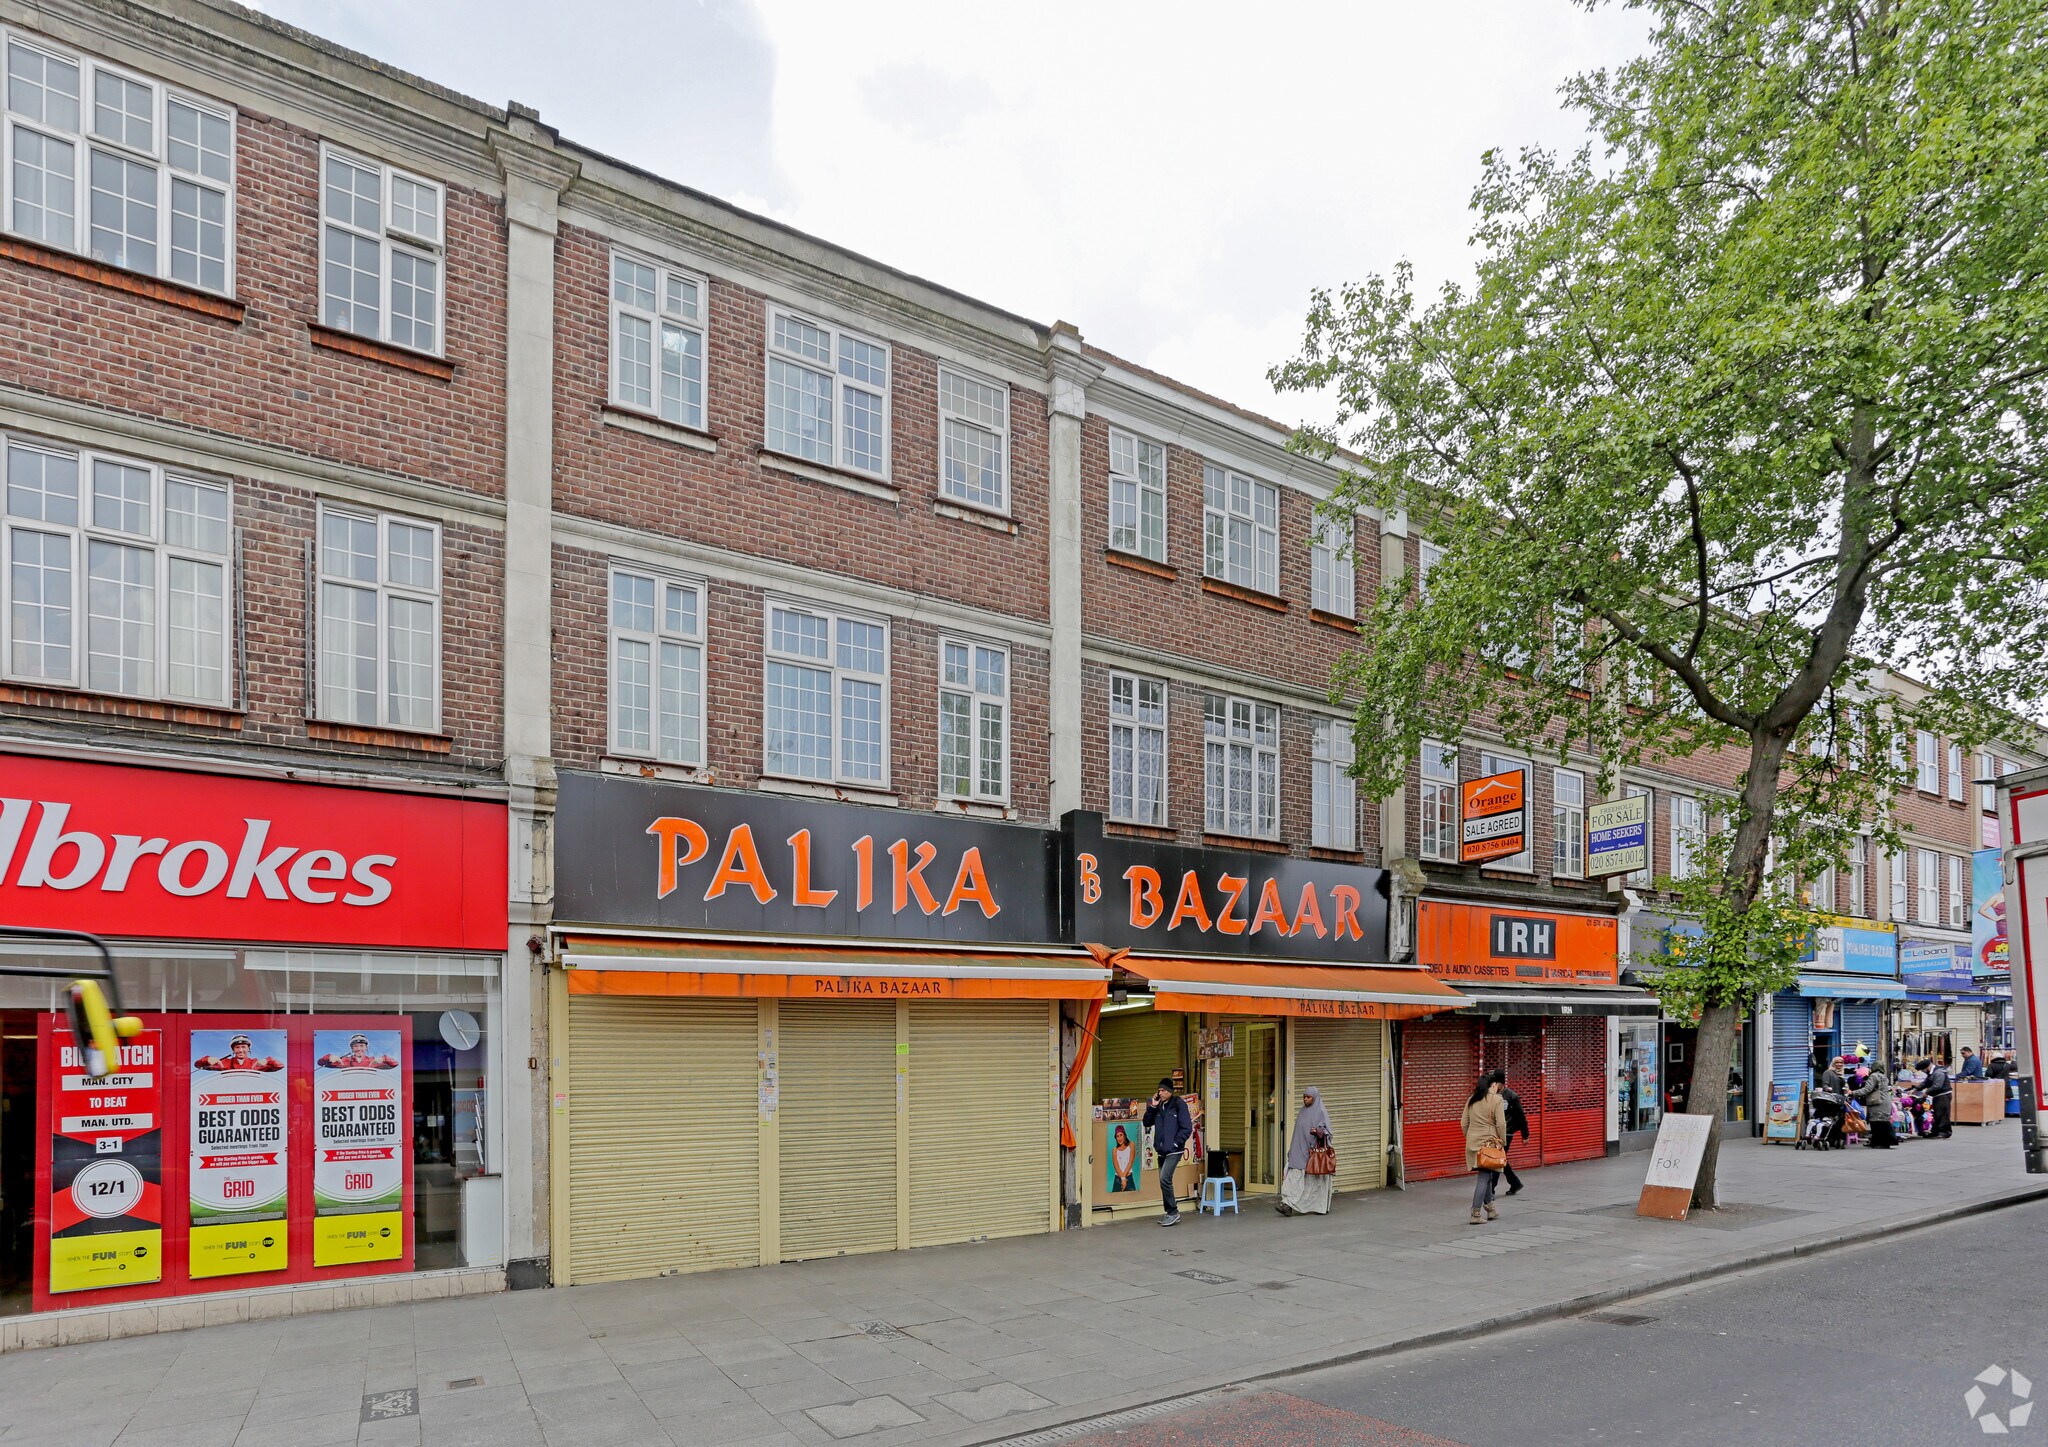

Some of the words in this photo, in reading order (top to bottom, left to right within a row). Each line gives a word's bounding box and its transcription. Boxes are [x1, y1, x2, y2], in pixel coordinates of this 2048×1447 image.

[1469, 792, 1517, 809] Orange
[1468, 804, 1503, 815] Properties
[1600, 803, 1634, 814] FREEHOLD
[1592, 813, 1613, 828] FOR
[1616, 807, 1642, 824] SALE
[1465, 823, 1486, 837] SALE
[1487, 816, 1520, 832] AGREED
[1591, 830, 1612, 843] HOME
[1612, 825, 1642, 840] SEEKERS
[1466, 845, 1480, 853] 020
[1481, 841, 1500, 851] 8756
[1501, 838, 1519, 848] 0404
[1591, 856, 1604, 870] 020
[1605, 852, 1623, 867] 8574
[1625, 848, 1644, 864] 0012
[645, 817, 1001, 919] PALIKA
[1122, 865, 1364, 942] BAZAAR
[1497, 920, 1550, 954] IRH
[1846, 942, 1871, 955] PUNJABI
[1871, 945, 1894, 958] BAZAAR
[1912, 947, 1948, 957] Lebara
[1445, 964, 1451, 973] &
[1452, 964, 1472, 975] AUDIO
[1474, 965, 1510, 976] CASSETTES
[815, 979, 874, 994] PALIKA
[880, 981, 942, 994] BAZAAR
[1300, 1002, 1335, 1014] PALIKA
[1338, 1004, 1375, 1016] BAZAAR
[1561, 1006, 1573, 1014] IRH
[114, 1045, 154, 1066] ATCH
[82, 1078, 109, 1086] MAN.
[112, 1076, 134, 1085] CITY
[89, 1097, 102, 1108] TO
[104, 1096, 128, 1108] BEAT
[198, 1110, 236, 1128] BEST
[240, 1108, 280, 1126] ODDS
[322, 1106, 355, 1123] BEST
[359, 1104, 395, 1121] ODDS
[81, 1119, 109, 1128] MAN.
[112, 1117, 134, 1127] UTD.
[322, 1121, 395, 1139] GUARANTEED
[1664, 1118, 1704, 1132] SPECIAL
[198, 1126, 280, 1144] GUARANTEED
[99, 1140, 118, 1150] 3-1
[1656, 1158, 1680, 1169] FOR
[89, 1180, 125, 1196] 12/1
[223, 1179, 255, 1198] GRID
[345, 1173, 373, 1190] GRID
[346, 1231, 367, 1239] FUN
[225, 1241, 247, 1250] FUN
[92, 1251, 117, 1261] FUN
